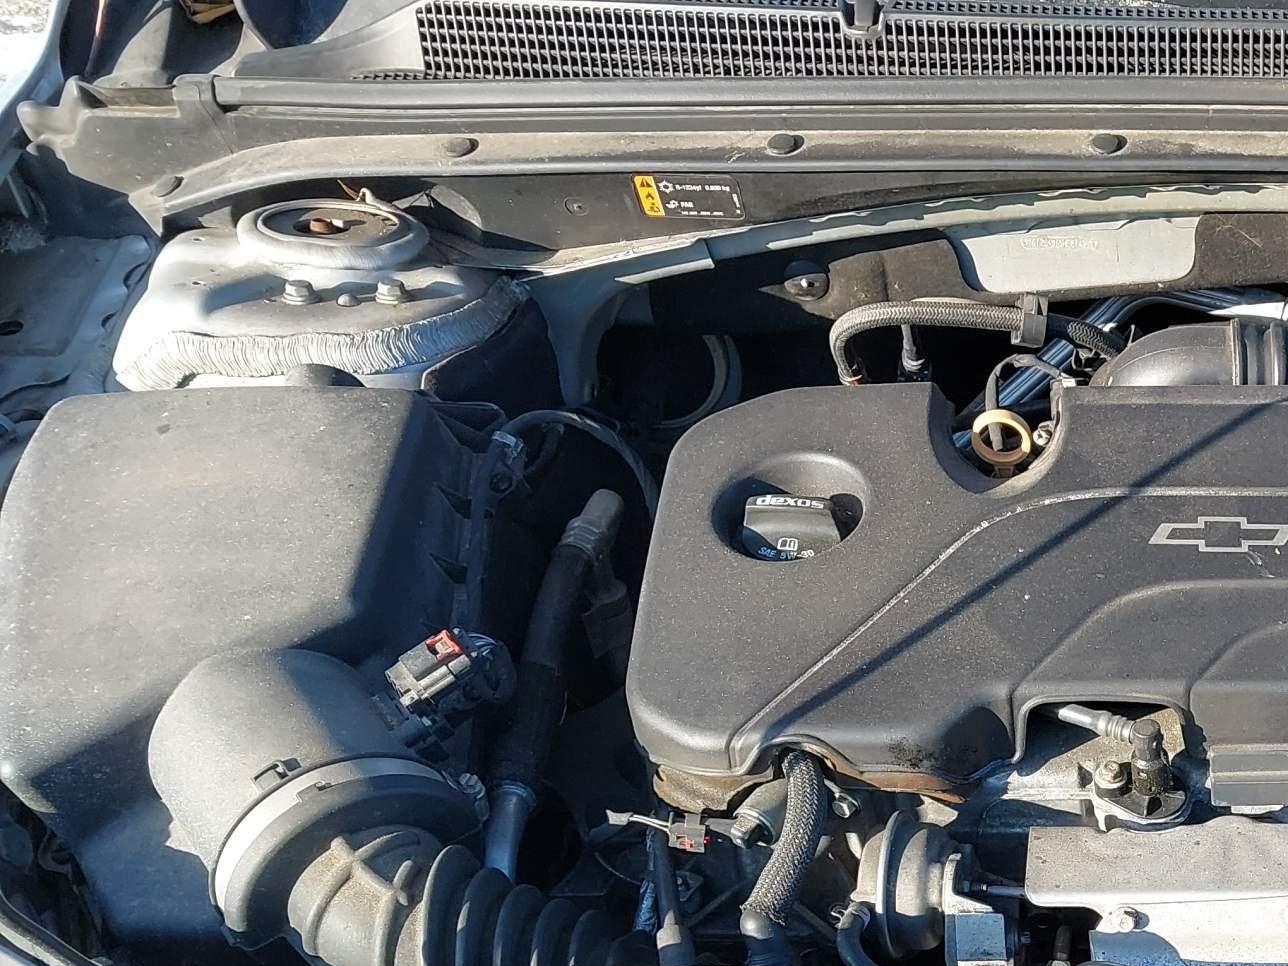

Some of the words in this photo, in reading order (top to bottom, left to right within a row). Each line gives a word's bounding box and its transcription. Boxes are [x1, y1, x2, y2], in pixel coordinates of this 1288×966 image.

[756, 495, 825, 509] dexos
[758, 546, 777, 557] SAE
[780, 549, 815, 560] 5W-30
